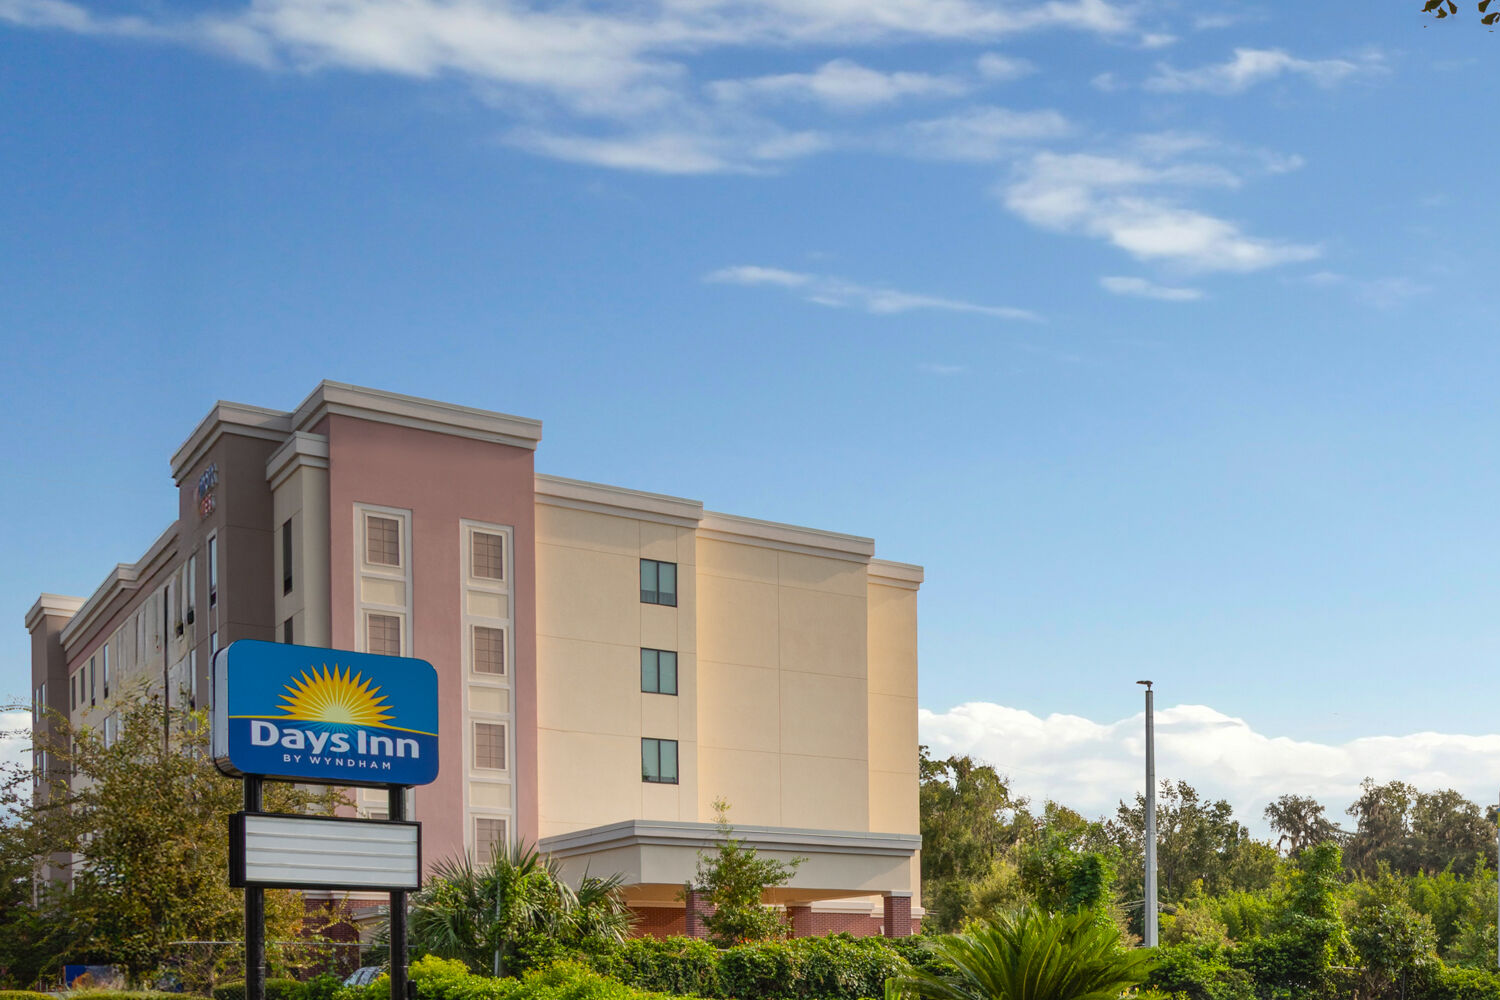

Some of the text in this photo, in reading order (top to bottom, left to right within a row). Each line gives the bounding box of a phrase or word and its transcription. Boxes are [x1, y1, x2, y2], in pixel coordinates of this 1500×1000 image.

[250, 719, 420, 759] Days Inn
[283, 753, 391, 770] BY WYNDHAM
